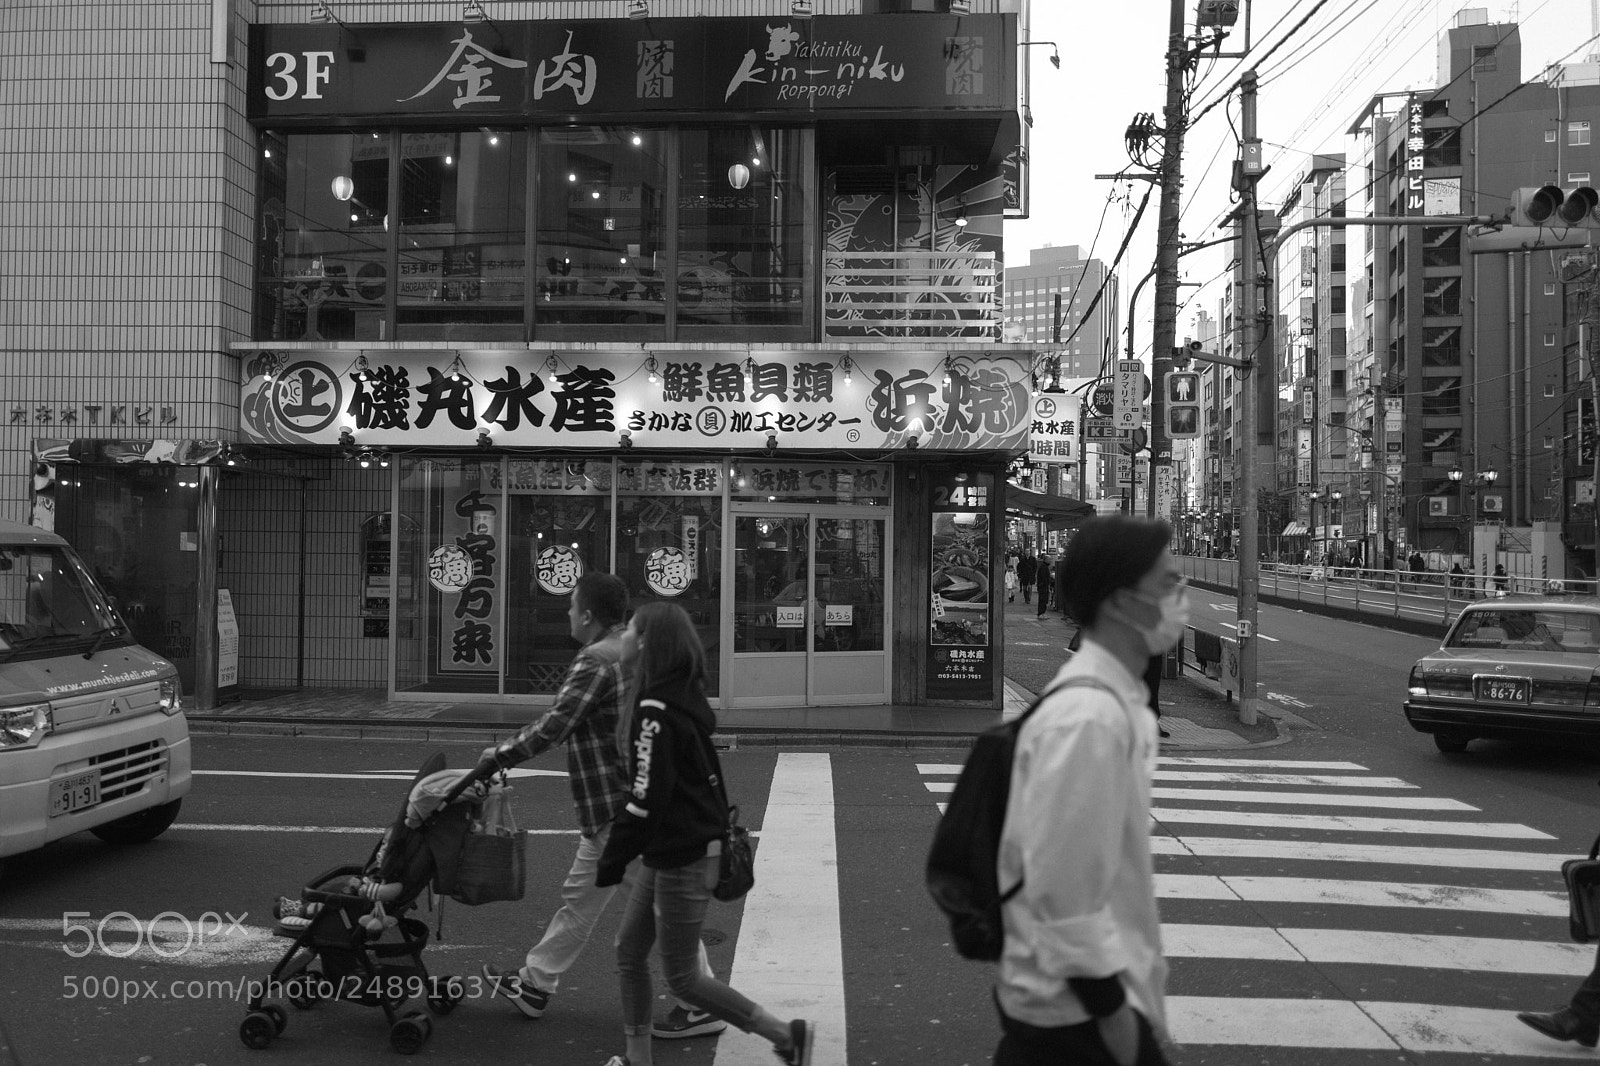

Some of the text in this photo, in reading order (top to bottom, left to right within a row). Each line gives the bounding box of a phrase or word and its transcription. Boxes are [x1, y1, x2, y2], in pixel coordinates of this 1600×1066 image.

[396, 28, 597, 109] 金肉
[637, 41, 674, 97] 焼肉
[794, 41, 862, 58] Yakiniku
[265, 51, 335, 100] 3F
[1407, 103, 1424, 210] 六本木幸田ビル
[346, 364, 616, 432] 磯丸水産
[662, 362, 836, 403] 鮮魚貝類
[870, 368, 1013, 434] 浜焼
[935, 486, 967, 506] 24
[777, 611, 804, 621] 入口は
[826, 611, 851, 621] あちら
[1490, 688, 1523, 700] 86-76
[632, 717, 661, 800] Supreme
[62, 784, 97, 811] 91-91
